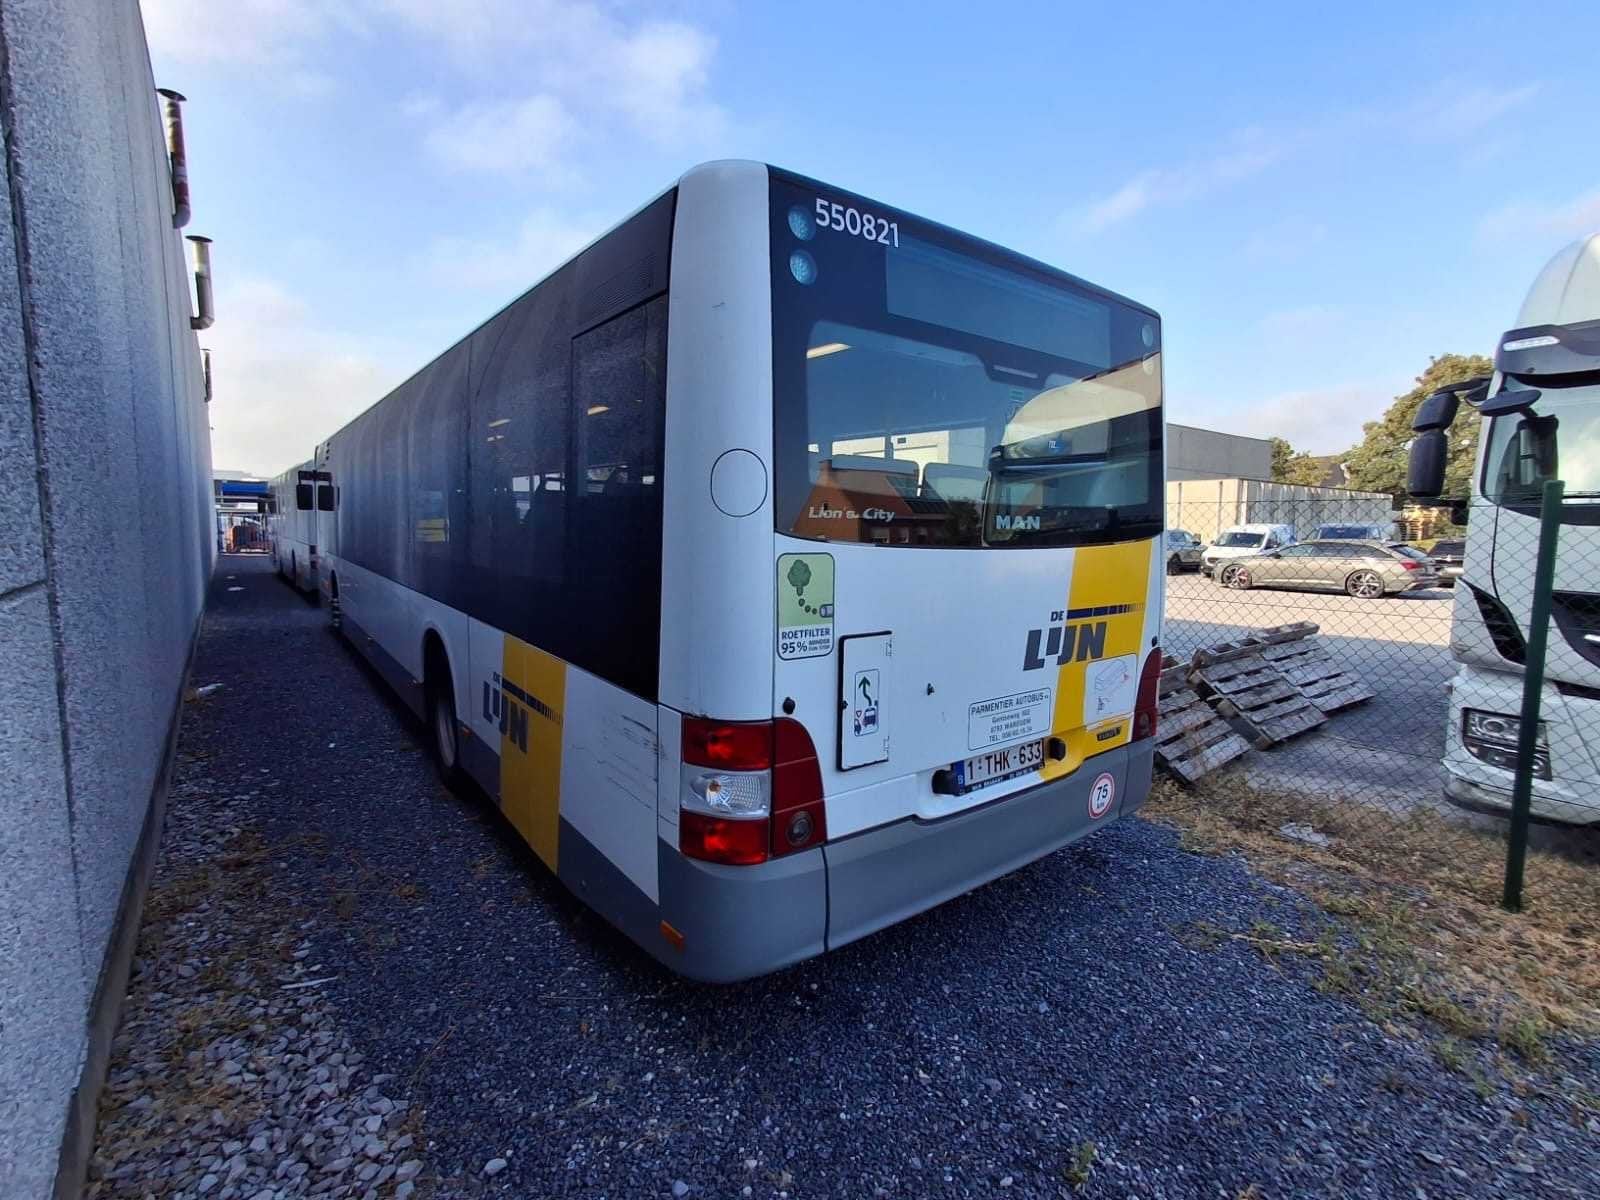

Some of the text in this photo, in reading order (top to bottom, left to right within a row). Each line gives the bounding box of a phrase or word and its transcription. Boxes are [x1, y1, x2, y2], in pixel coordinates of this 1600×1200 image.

[815, 198, 899, 248] 550821
[863, 506, 896, 523] City
[995, 515, 1040, 530] MAN
[1050, 611, 1064, 622] DE
[781, 628, 830, 640] ROETFILTER
[1023, 621, 1107, 671] LIJN
[971, 698, 1014, 715] PARMENTIER
[1016, 692, 1044, 705] AUTOBUS
[482, 681, 528, 755] LIJN
[1097, 784, 1109, 801] 75
